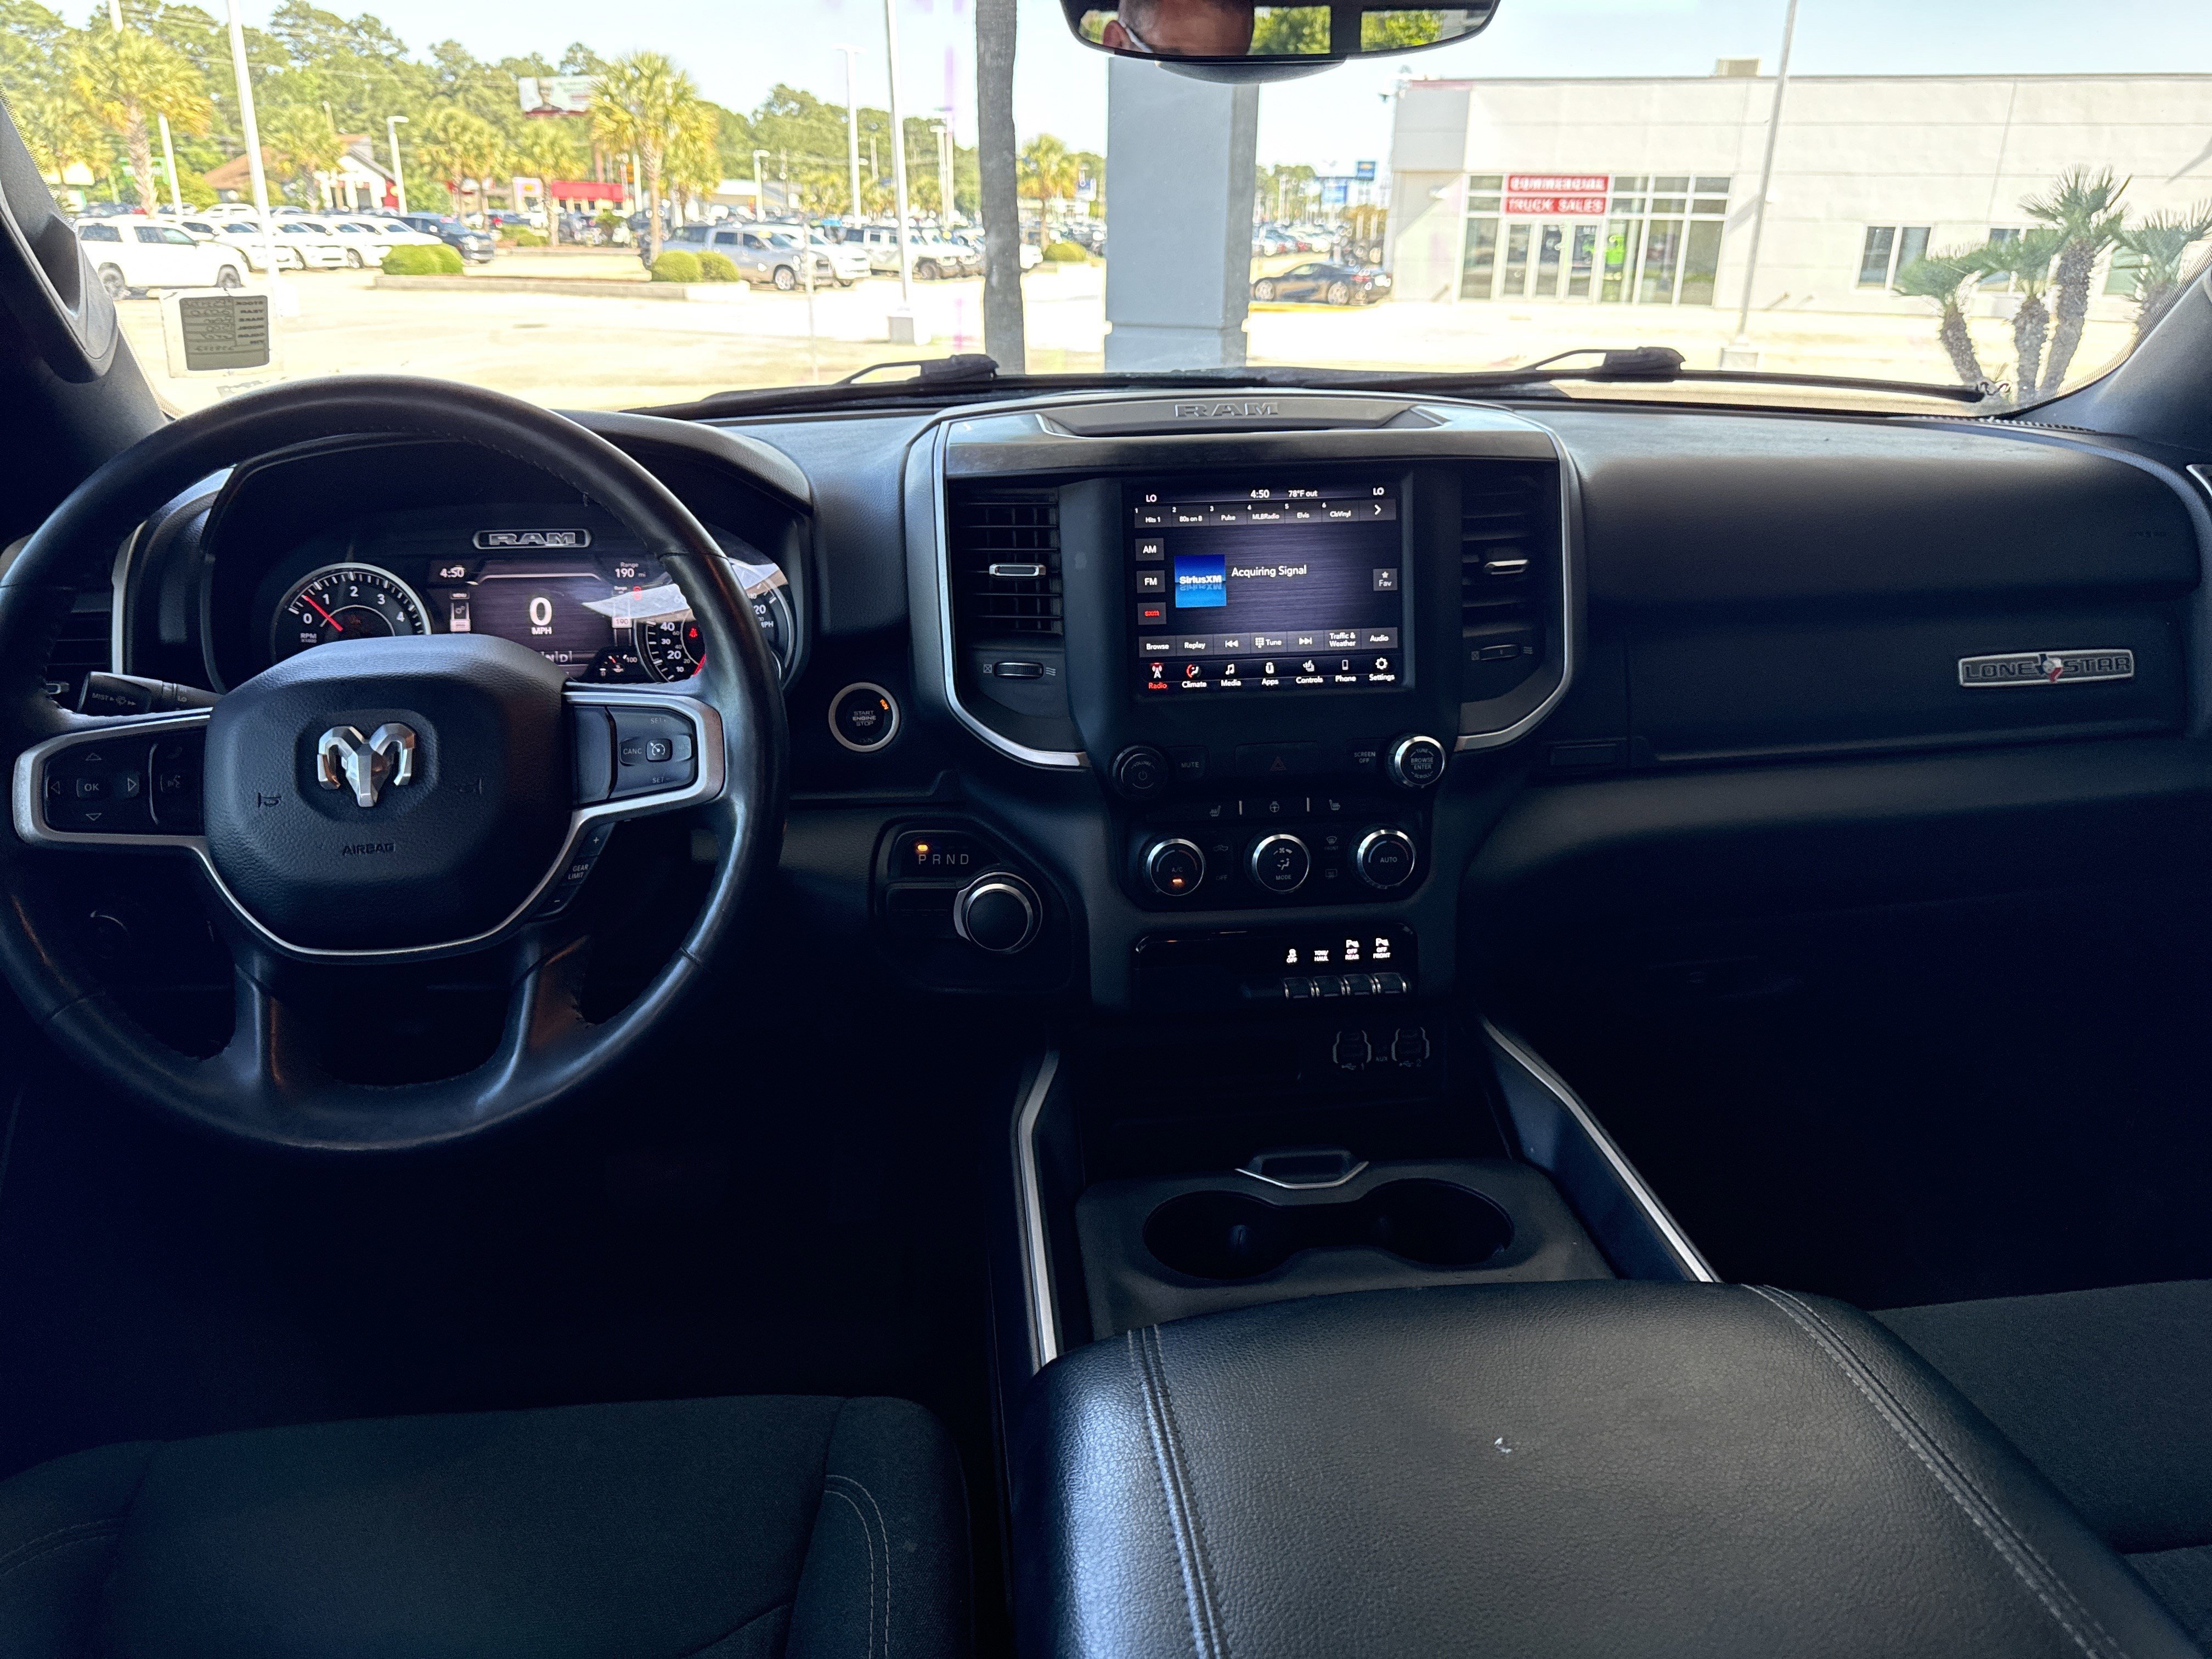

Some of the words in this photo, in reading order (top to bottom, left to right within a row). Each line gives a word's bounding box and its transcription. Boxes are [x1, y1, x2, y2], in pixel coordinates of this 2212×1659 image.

[1510, 177, 1604, 191] COMMERCIAL
[1509, 198, 1554, 213] TRUCK
[1558, 198, 1603, 213] SALES
[1175, 402, 1279, 417] RAM
[1250, 489, 1270, 499] 4:50
[1373, 487, 1385, 496] LO
[1146, 494, 1157, 503] LO
[489, 532, 576, 546] RAM
[1143, 545, 1157, 554] AM
[439, 567, 465, 578] 4:50
[615, 568, 635, 578] 190
[1231, 566, 1276, 578] Acquiring
[1278, 564, 1307, 577] Signal
[1144, 577, 1158, 586] FM
[1179, 575, 1222, 585] SiriusXM
[349, 585, 359, 597] 2
[322, 593, 330, 605] 1
[377, 593, 386, 605] 3
[529, 596, 552, 627] 0
[753, 603, 767, 615] 20
[303, 613, 313, 624] 0
[396, 611, 405, 622] 4
[531, 627, 552, 635] MPH
[660, 622, 675, 631] 40
[1329, 631, 1349, 640] Traffic
[1184, 641, 1206, 650] Replay
[1329, 639, 1356, 647] Weather
[560, 654, 569, 663] D
[667, 650, 682, 659] 20
[1963, 661, 2037, 680] LONE
[2063, 657, 2131, 673] STAR
[1261, 678, 1279, 686] Apps
[1295, 675, 1324, 684] Controls
[1369, 673, 1396, 682] Settings
[1181, 680, 1207, 689] Climate
[92, 692, 109, 701] MIST
[84, 783, 100, 792] OK
[342, 843, 396, 856] AIRBAG
[918, 854, 927, 865] P
[932, 854, 941, 865] R
[946, 854, 955, 865] N
[960, 854, 969, 865] D
[572, 864, 589, 872] GEAR
[568, 871, 585, 880] LIMIT
